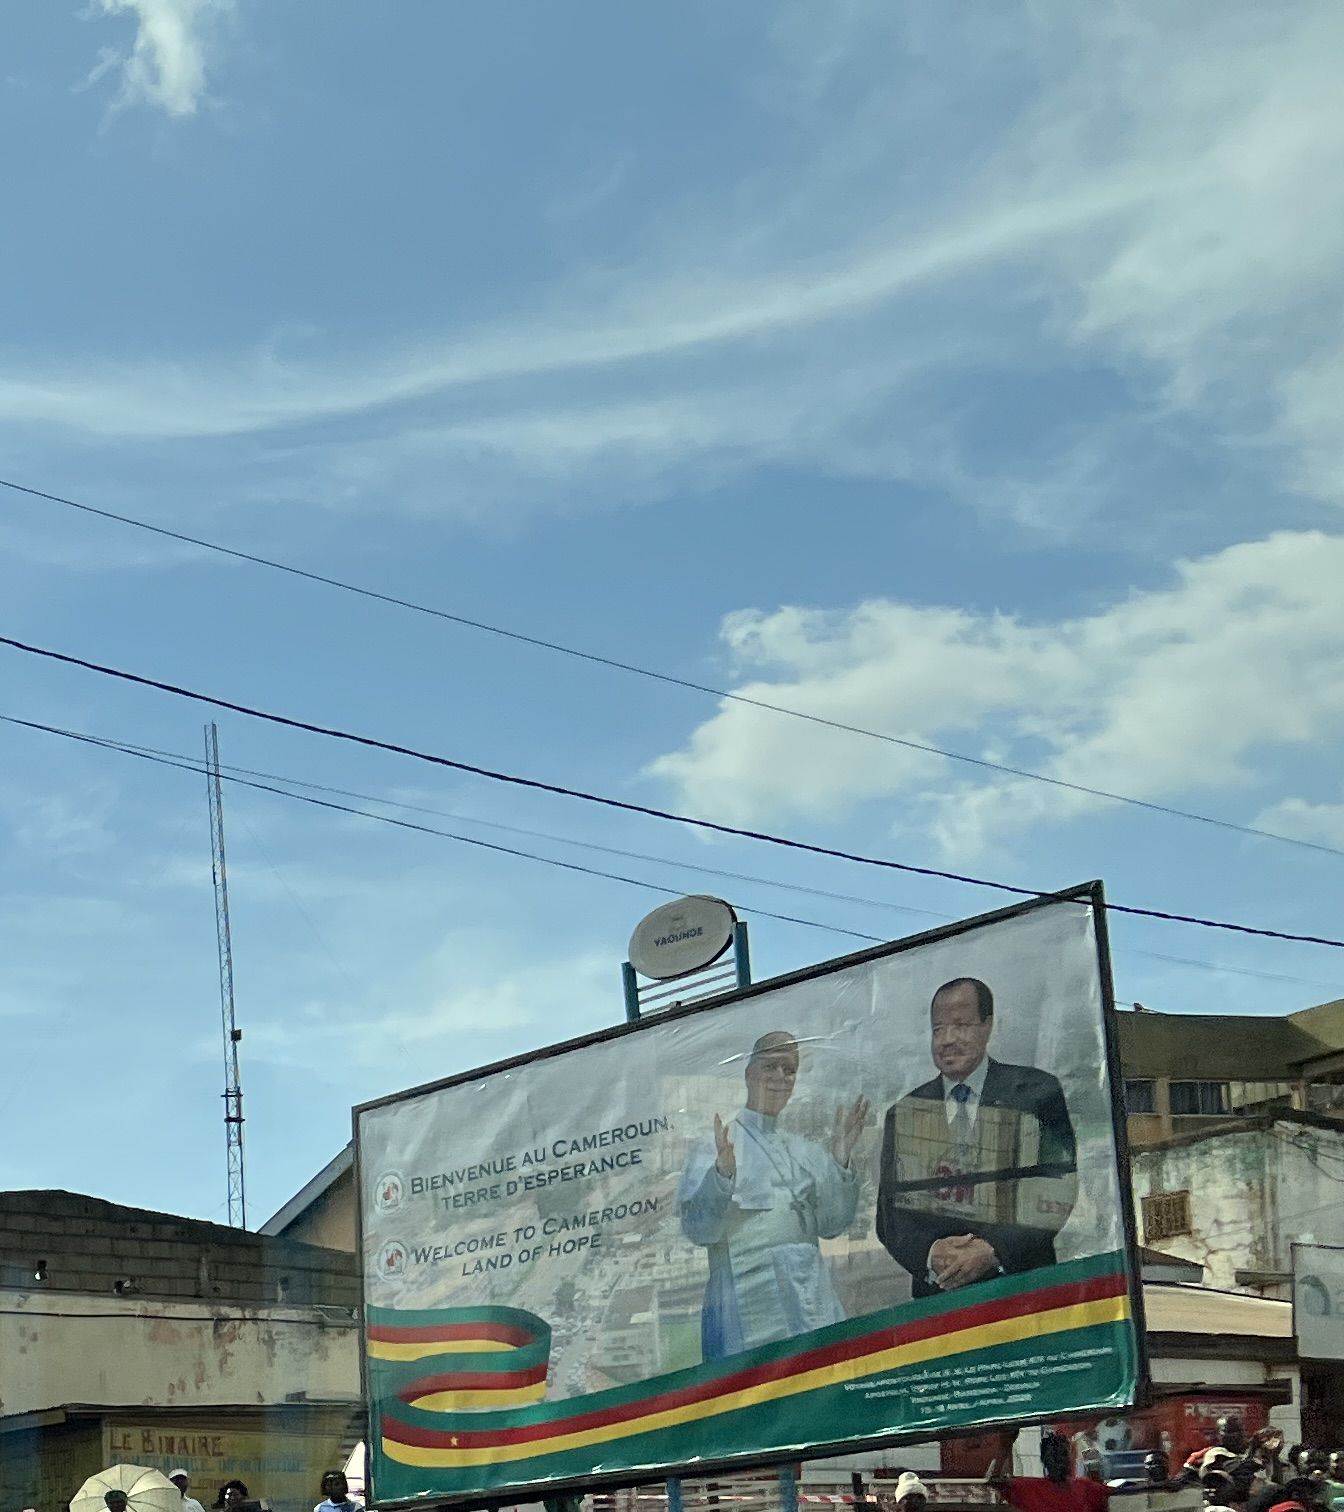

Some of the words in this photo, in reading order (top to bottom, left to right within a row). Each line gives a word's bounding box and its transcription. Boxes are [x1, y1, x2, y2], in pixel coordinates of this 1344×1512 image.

[410, 1155, 517, 1195] BIENVENUE
[521, 1146, 547, 1168] AU
[441, 1183, 500, 1210] TERRE
[413, 1232, 508, 1265] WELCOME
[513, 1225, 536, 1244] TO
[462, 1252, 512, 1277] LAND
[517, 1247, 543, 1264] OF
[548, 1232, 603, 1258] HOPE
[141, 1428, 224, 1457] BINAIRE
